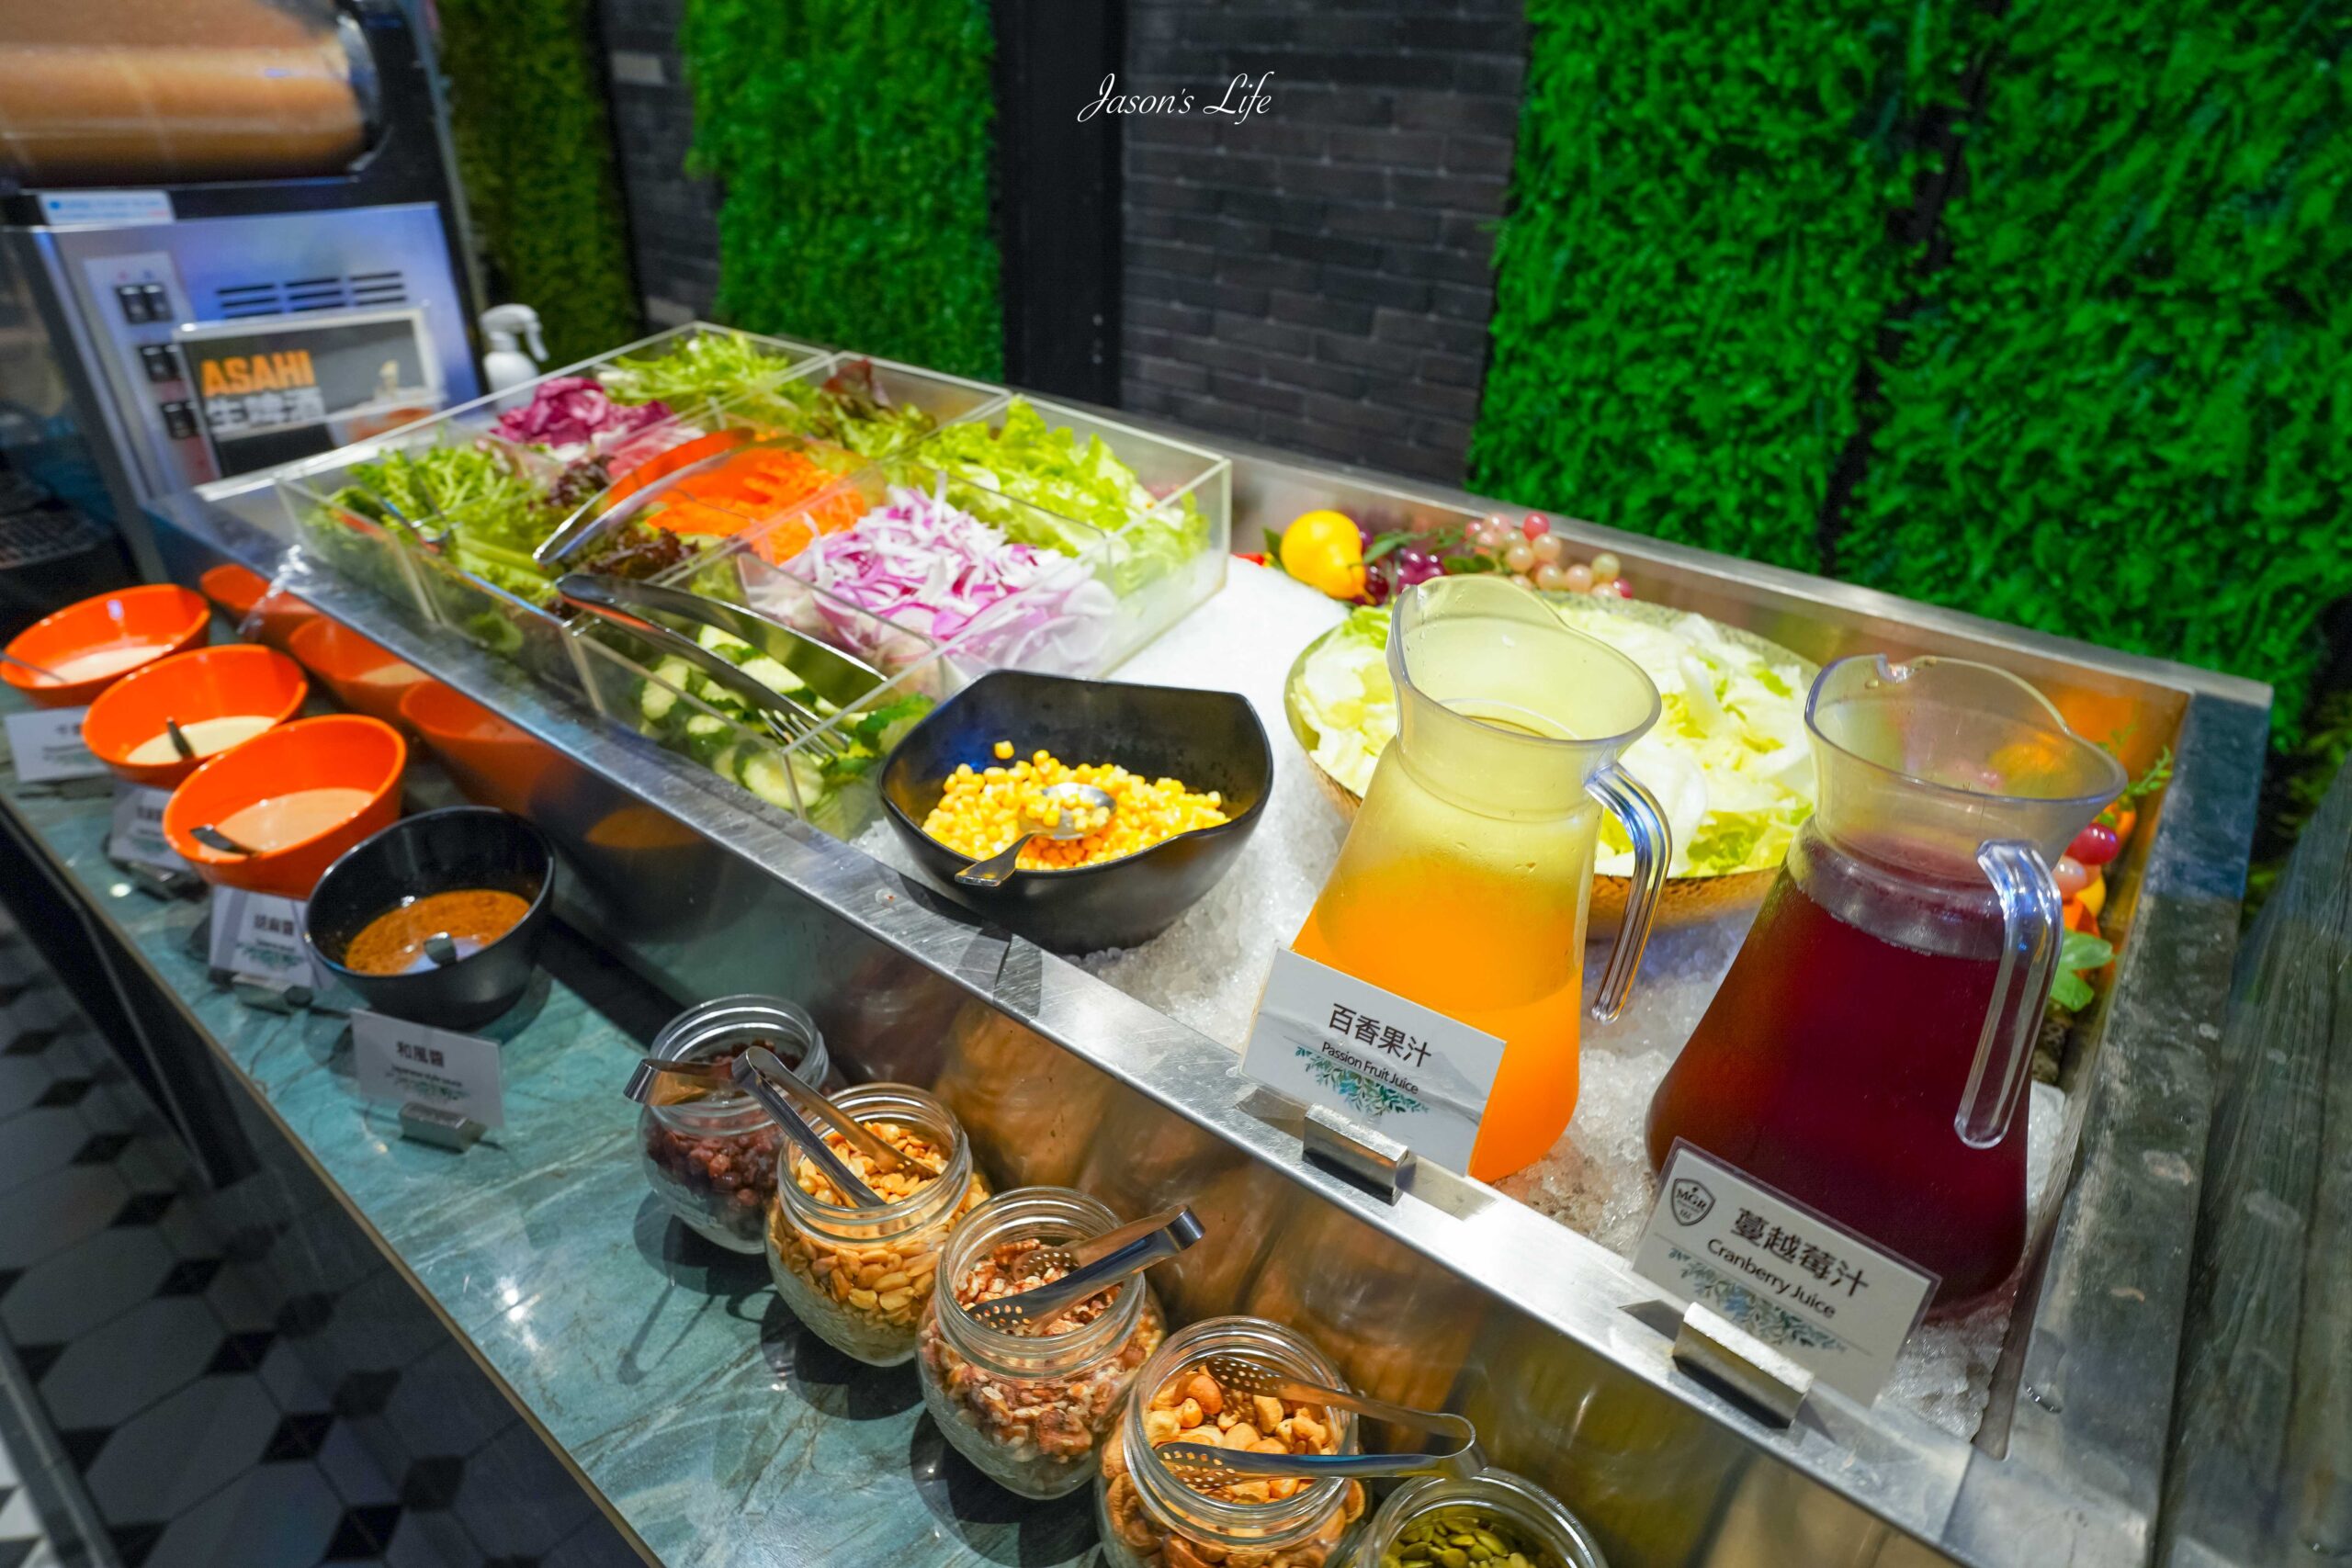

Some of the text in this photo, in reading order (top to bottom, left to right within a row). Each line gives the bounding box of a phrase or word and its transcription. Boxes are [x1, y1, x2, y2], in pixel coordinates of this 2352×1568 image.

[201, 349, 316, 397] ASAHI
[1329, 1002, 1432, 1067] 百香果汁
[1321, 1041, 1420, 1095] Passion Fruit Juice
[1708, 1238, 1836, 1319] Cranberry Juice
[1730, 1207, 1869, 1297] 蔓越莓汁
